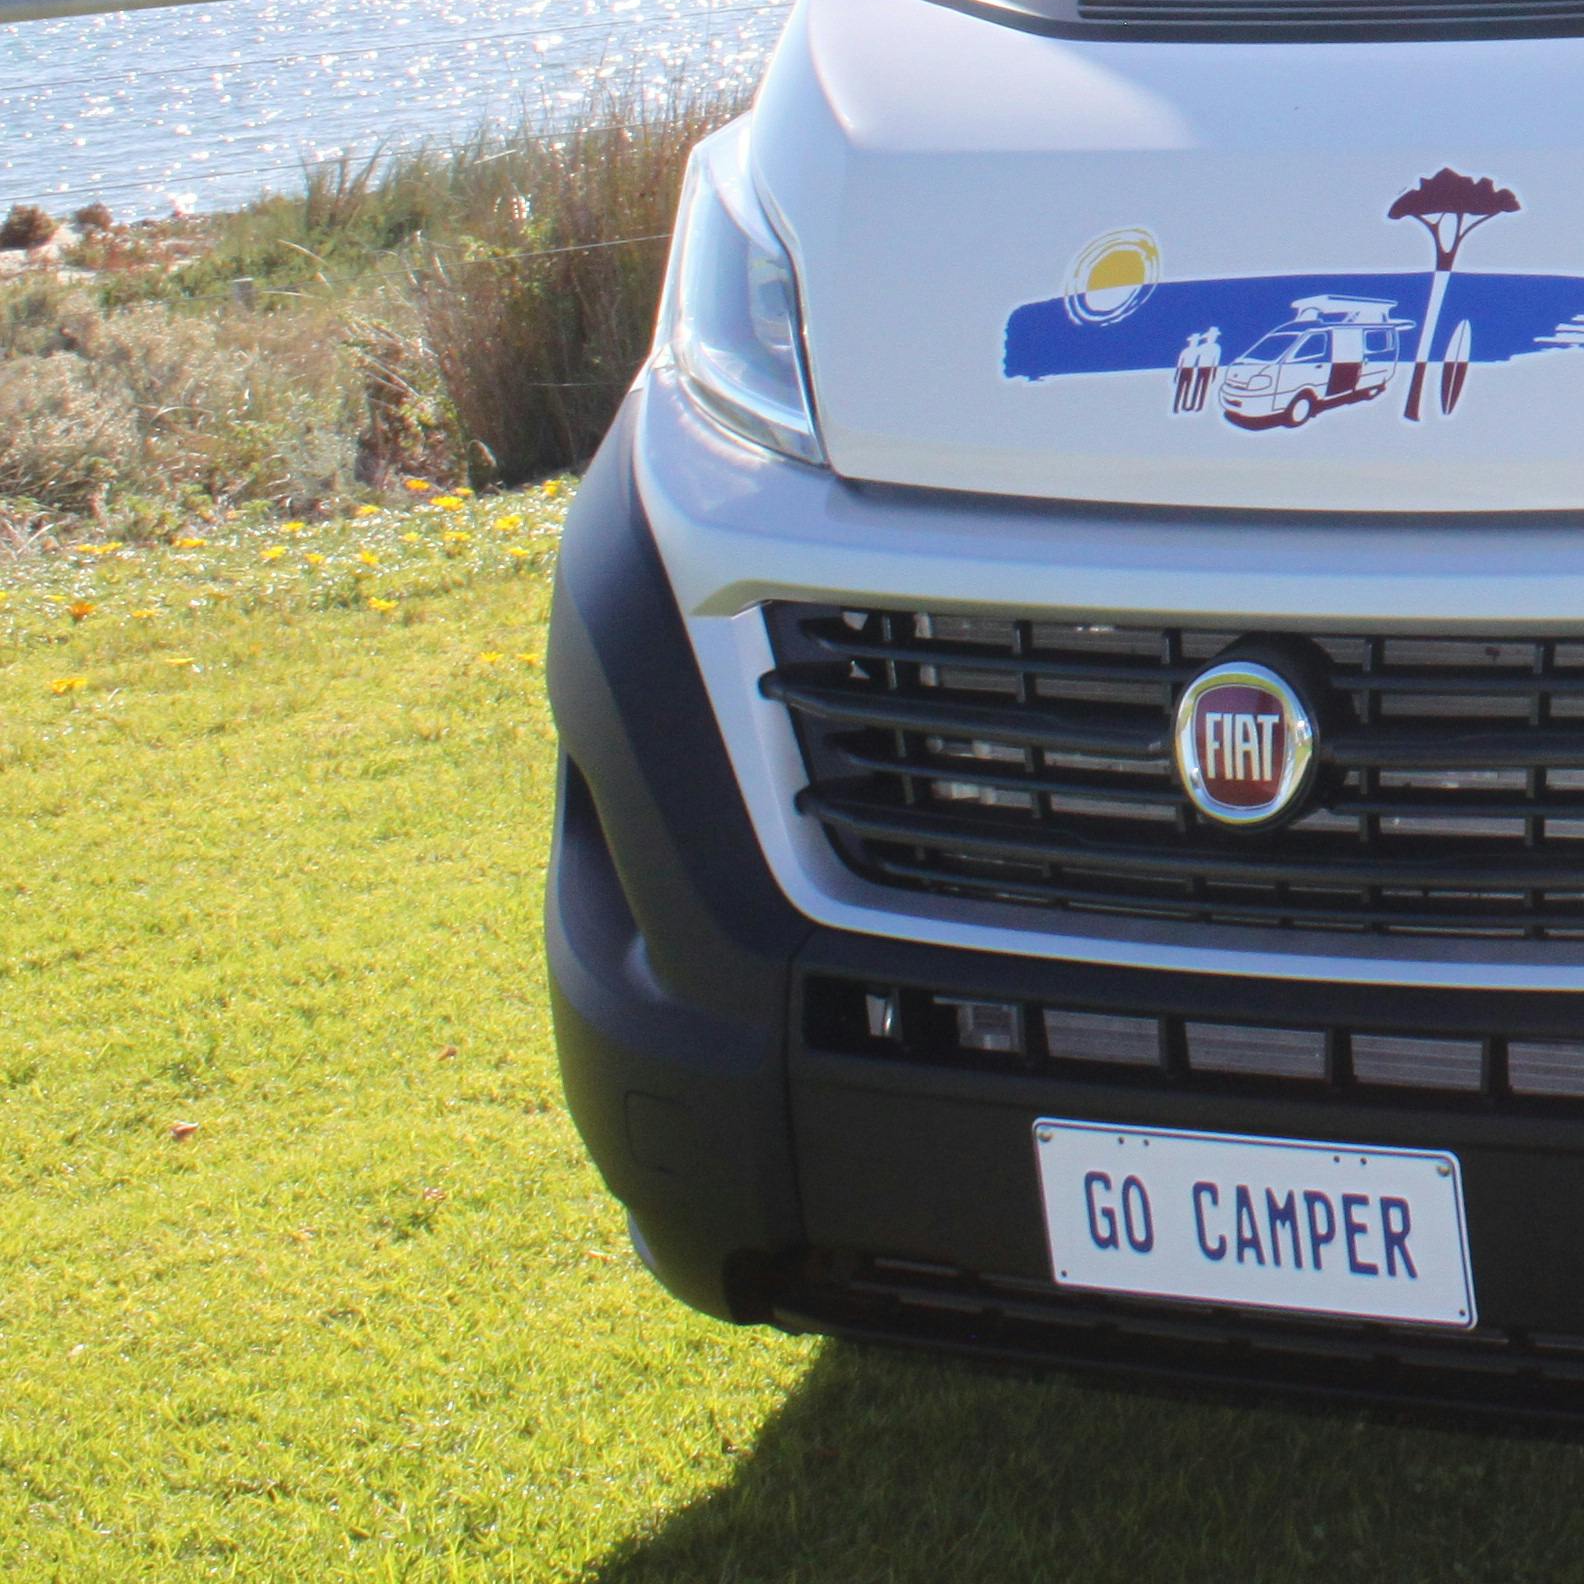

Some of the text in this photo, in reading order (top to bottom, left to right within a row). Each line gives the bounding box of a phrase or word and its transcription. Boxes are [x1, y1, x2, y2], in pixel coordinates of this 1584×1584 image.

[1204, 712, 1280, 782] FIAT
[1084, 1170, 1418, 1279] GO CAMPER
